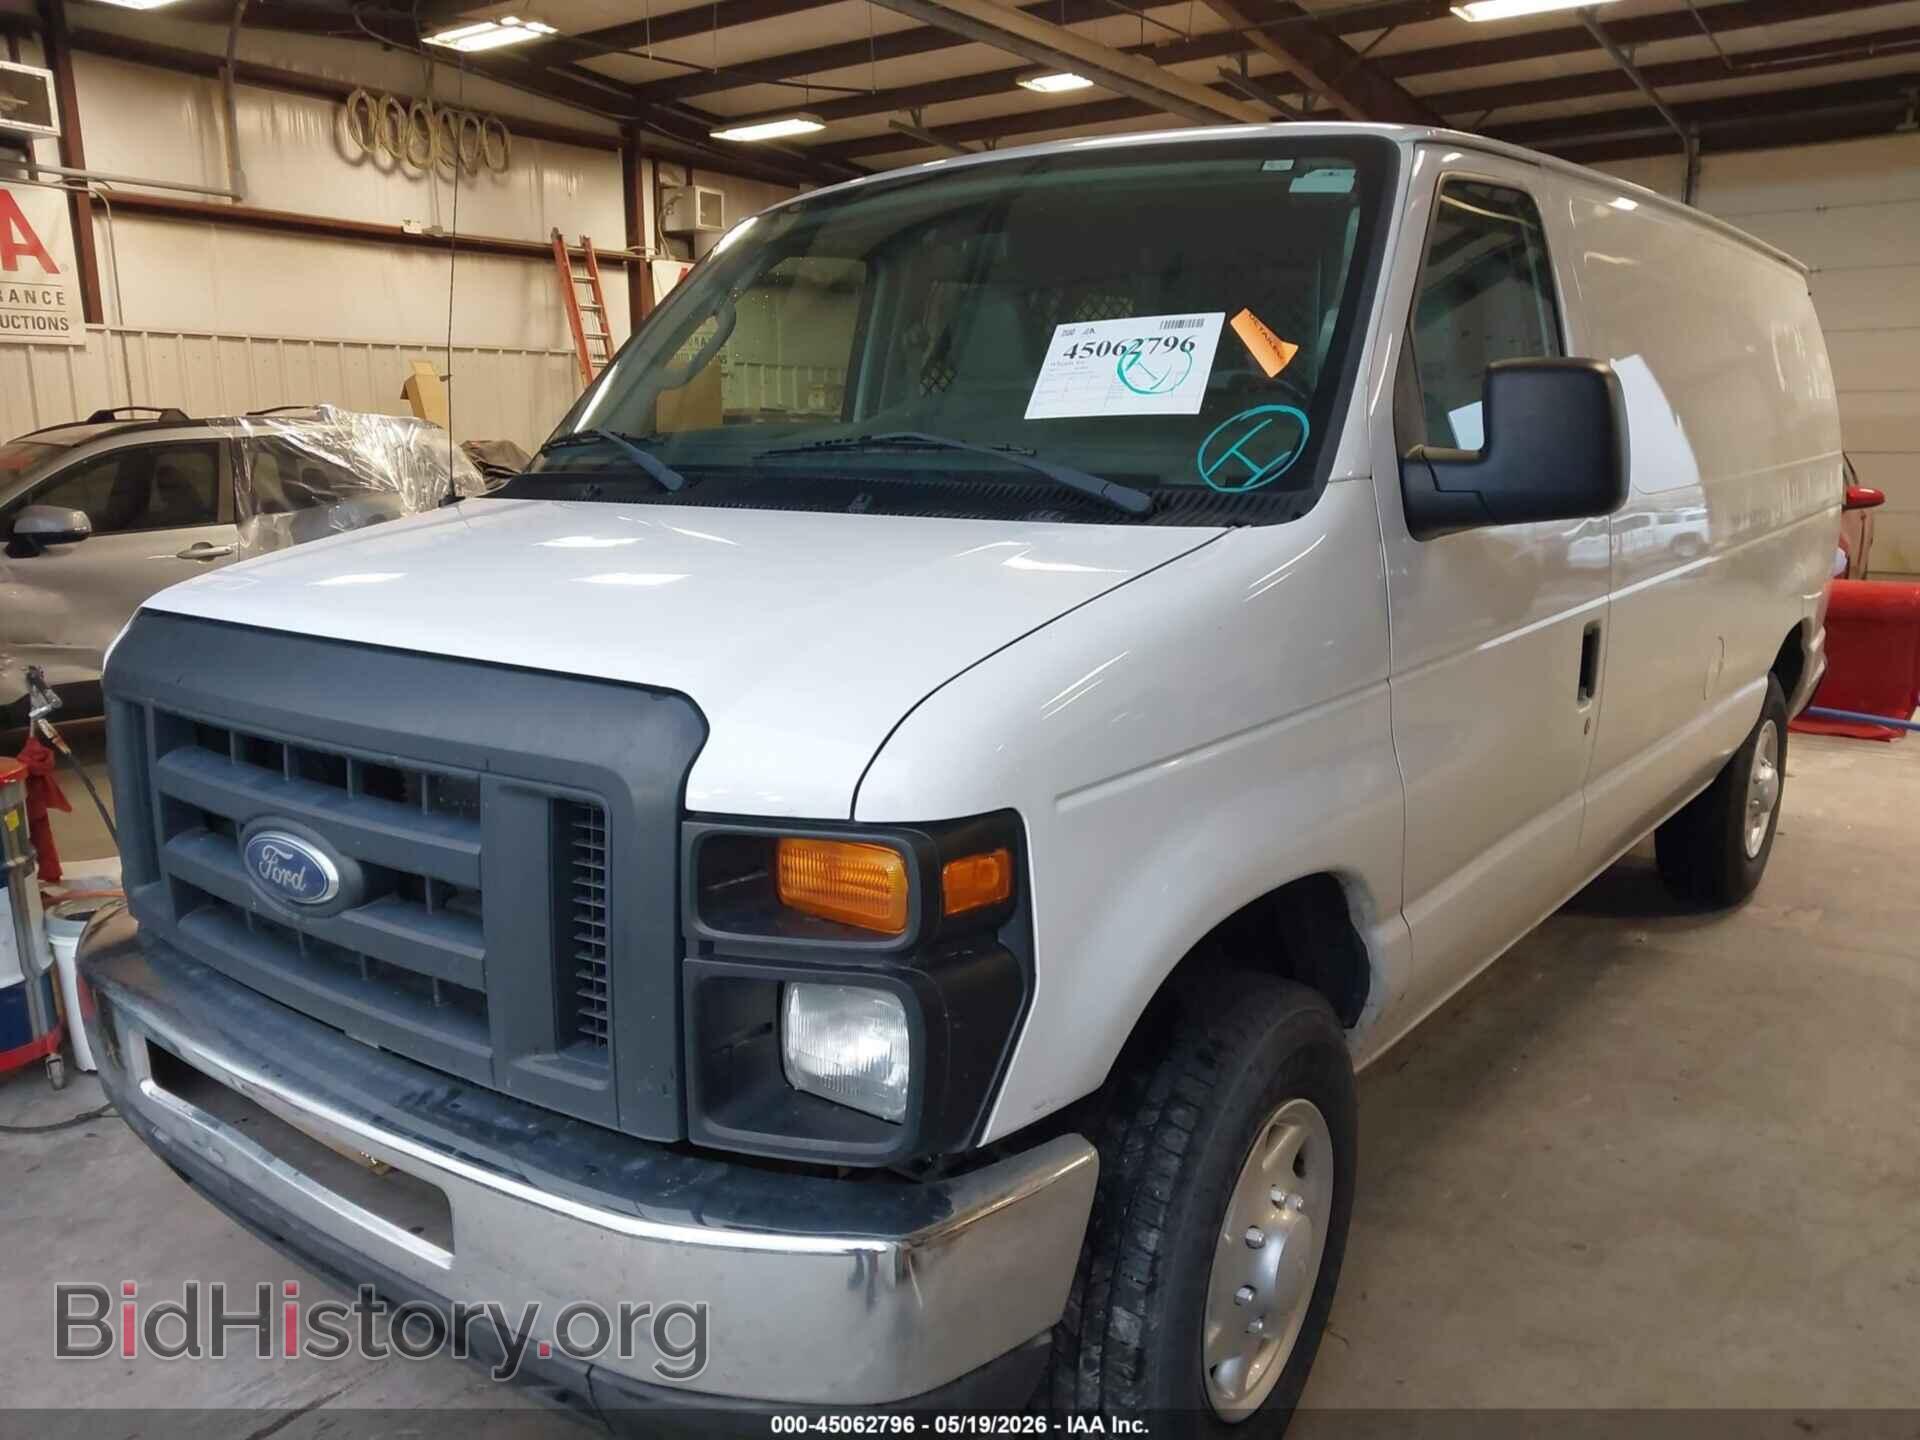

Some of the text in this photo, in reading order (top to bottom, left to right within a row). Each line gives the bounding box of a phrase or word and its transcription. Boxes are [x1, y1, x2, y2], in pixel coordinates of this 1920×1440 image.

[0, 314, 70, 331] UCTIONS
[1063, 335, 1197, 360] 45062796
[258, 844, 307, 892] Ford
